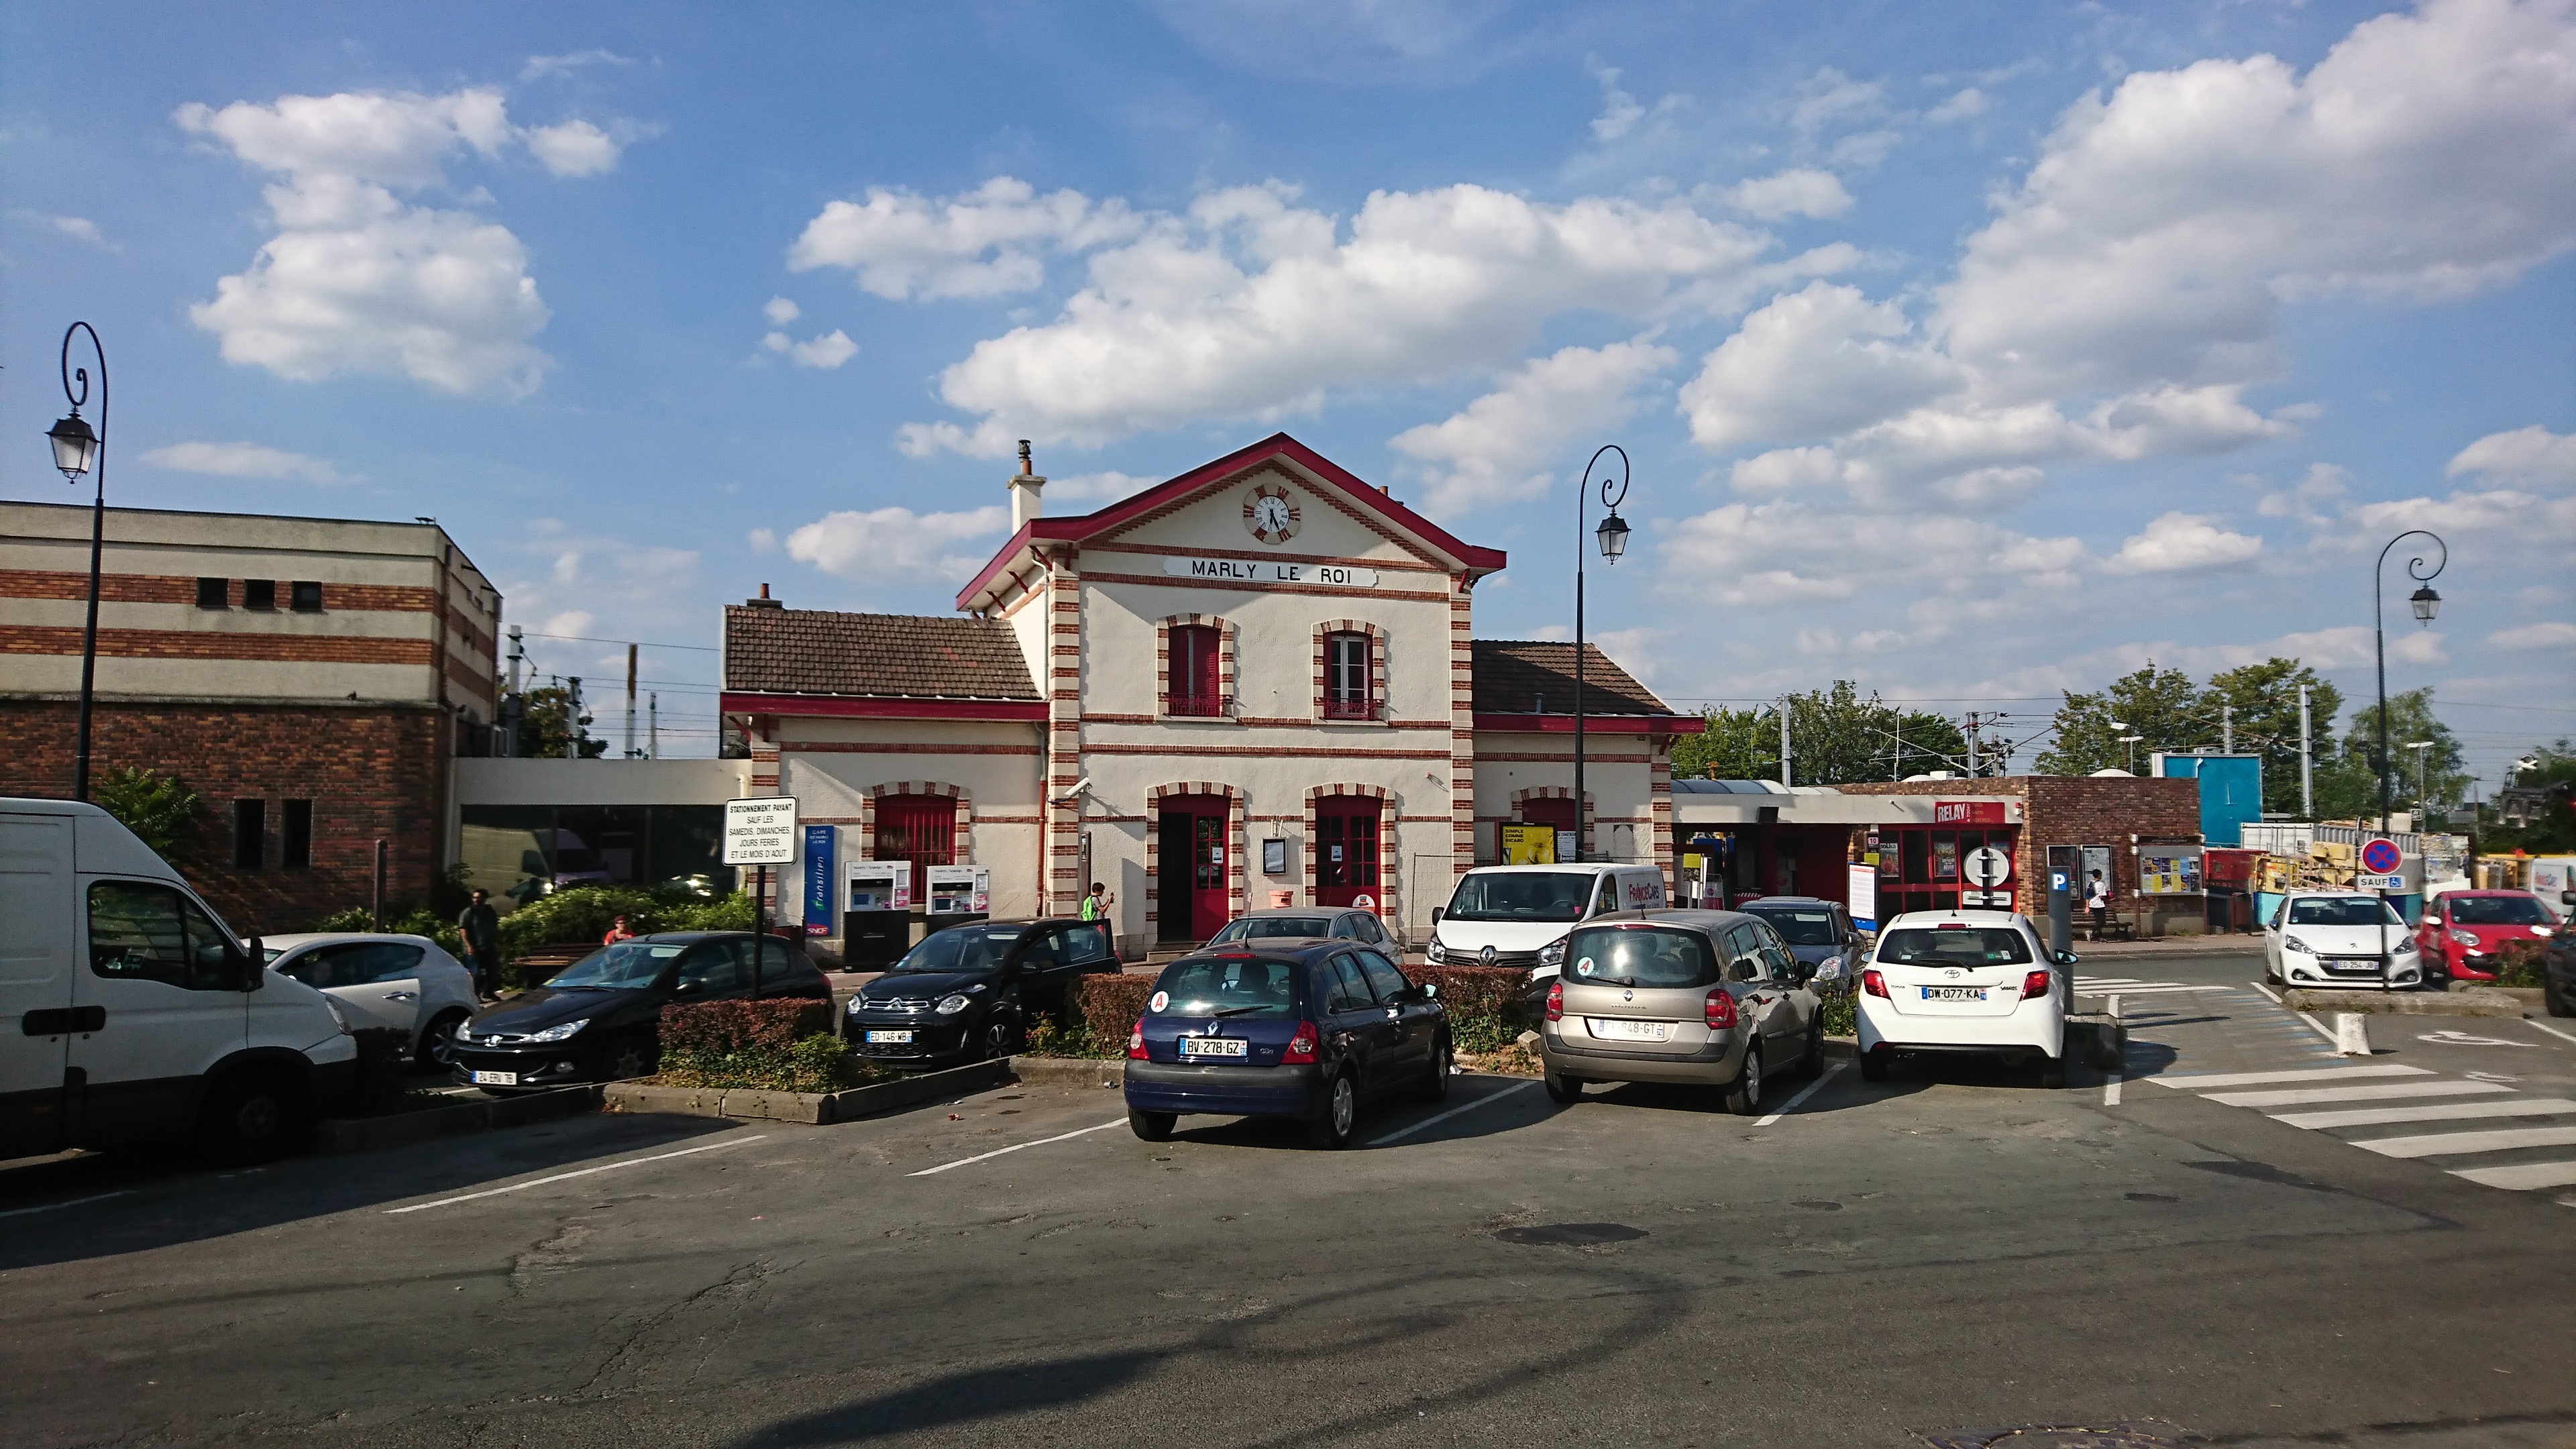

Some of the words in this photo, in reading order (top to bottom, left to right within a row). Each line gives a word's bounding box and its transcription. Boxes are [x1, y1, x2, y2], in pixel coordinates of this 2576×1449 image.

[1191, 560, 1256, 579] MARLY
[1277, 566, 1301, 581] LE
[1321, 568, 1351, 584] ROI
[730, 804, 771, 813] STATIONNEMENT
[1937, 803, 1966, 822] RELAY
[747, 816, 761, 824] SAUF
[731, 851, 739, 859] ET
[749, 850, 763, 858] MOIS
[816, 856, 824, 907] Transilien
[2053, 874, 2065, 890] P
[807, 926, 828, 934] SNCF
[1580, 960, 1590, 973] A
[1927, 989, 1980, 998] DW-077-KA
[1155, 994, 1163, 1008] A
[871, 1032, 906, 1041] ED-146-WB
[1187, 1041, 1239, 1054] BV-278-GZ
